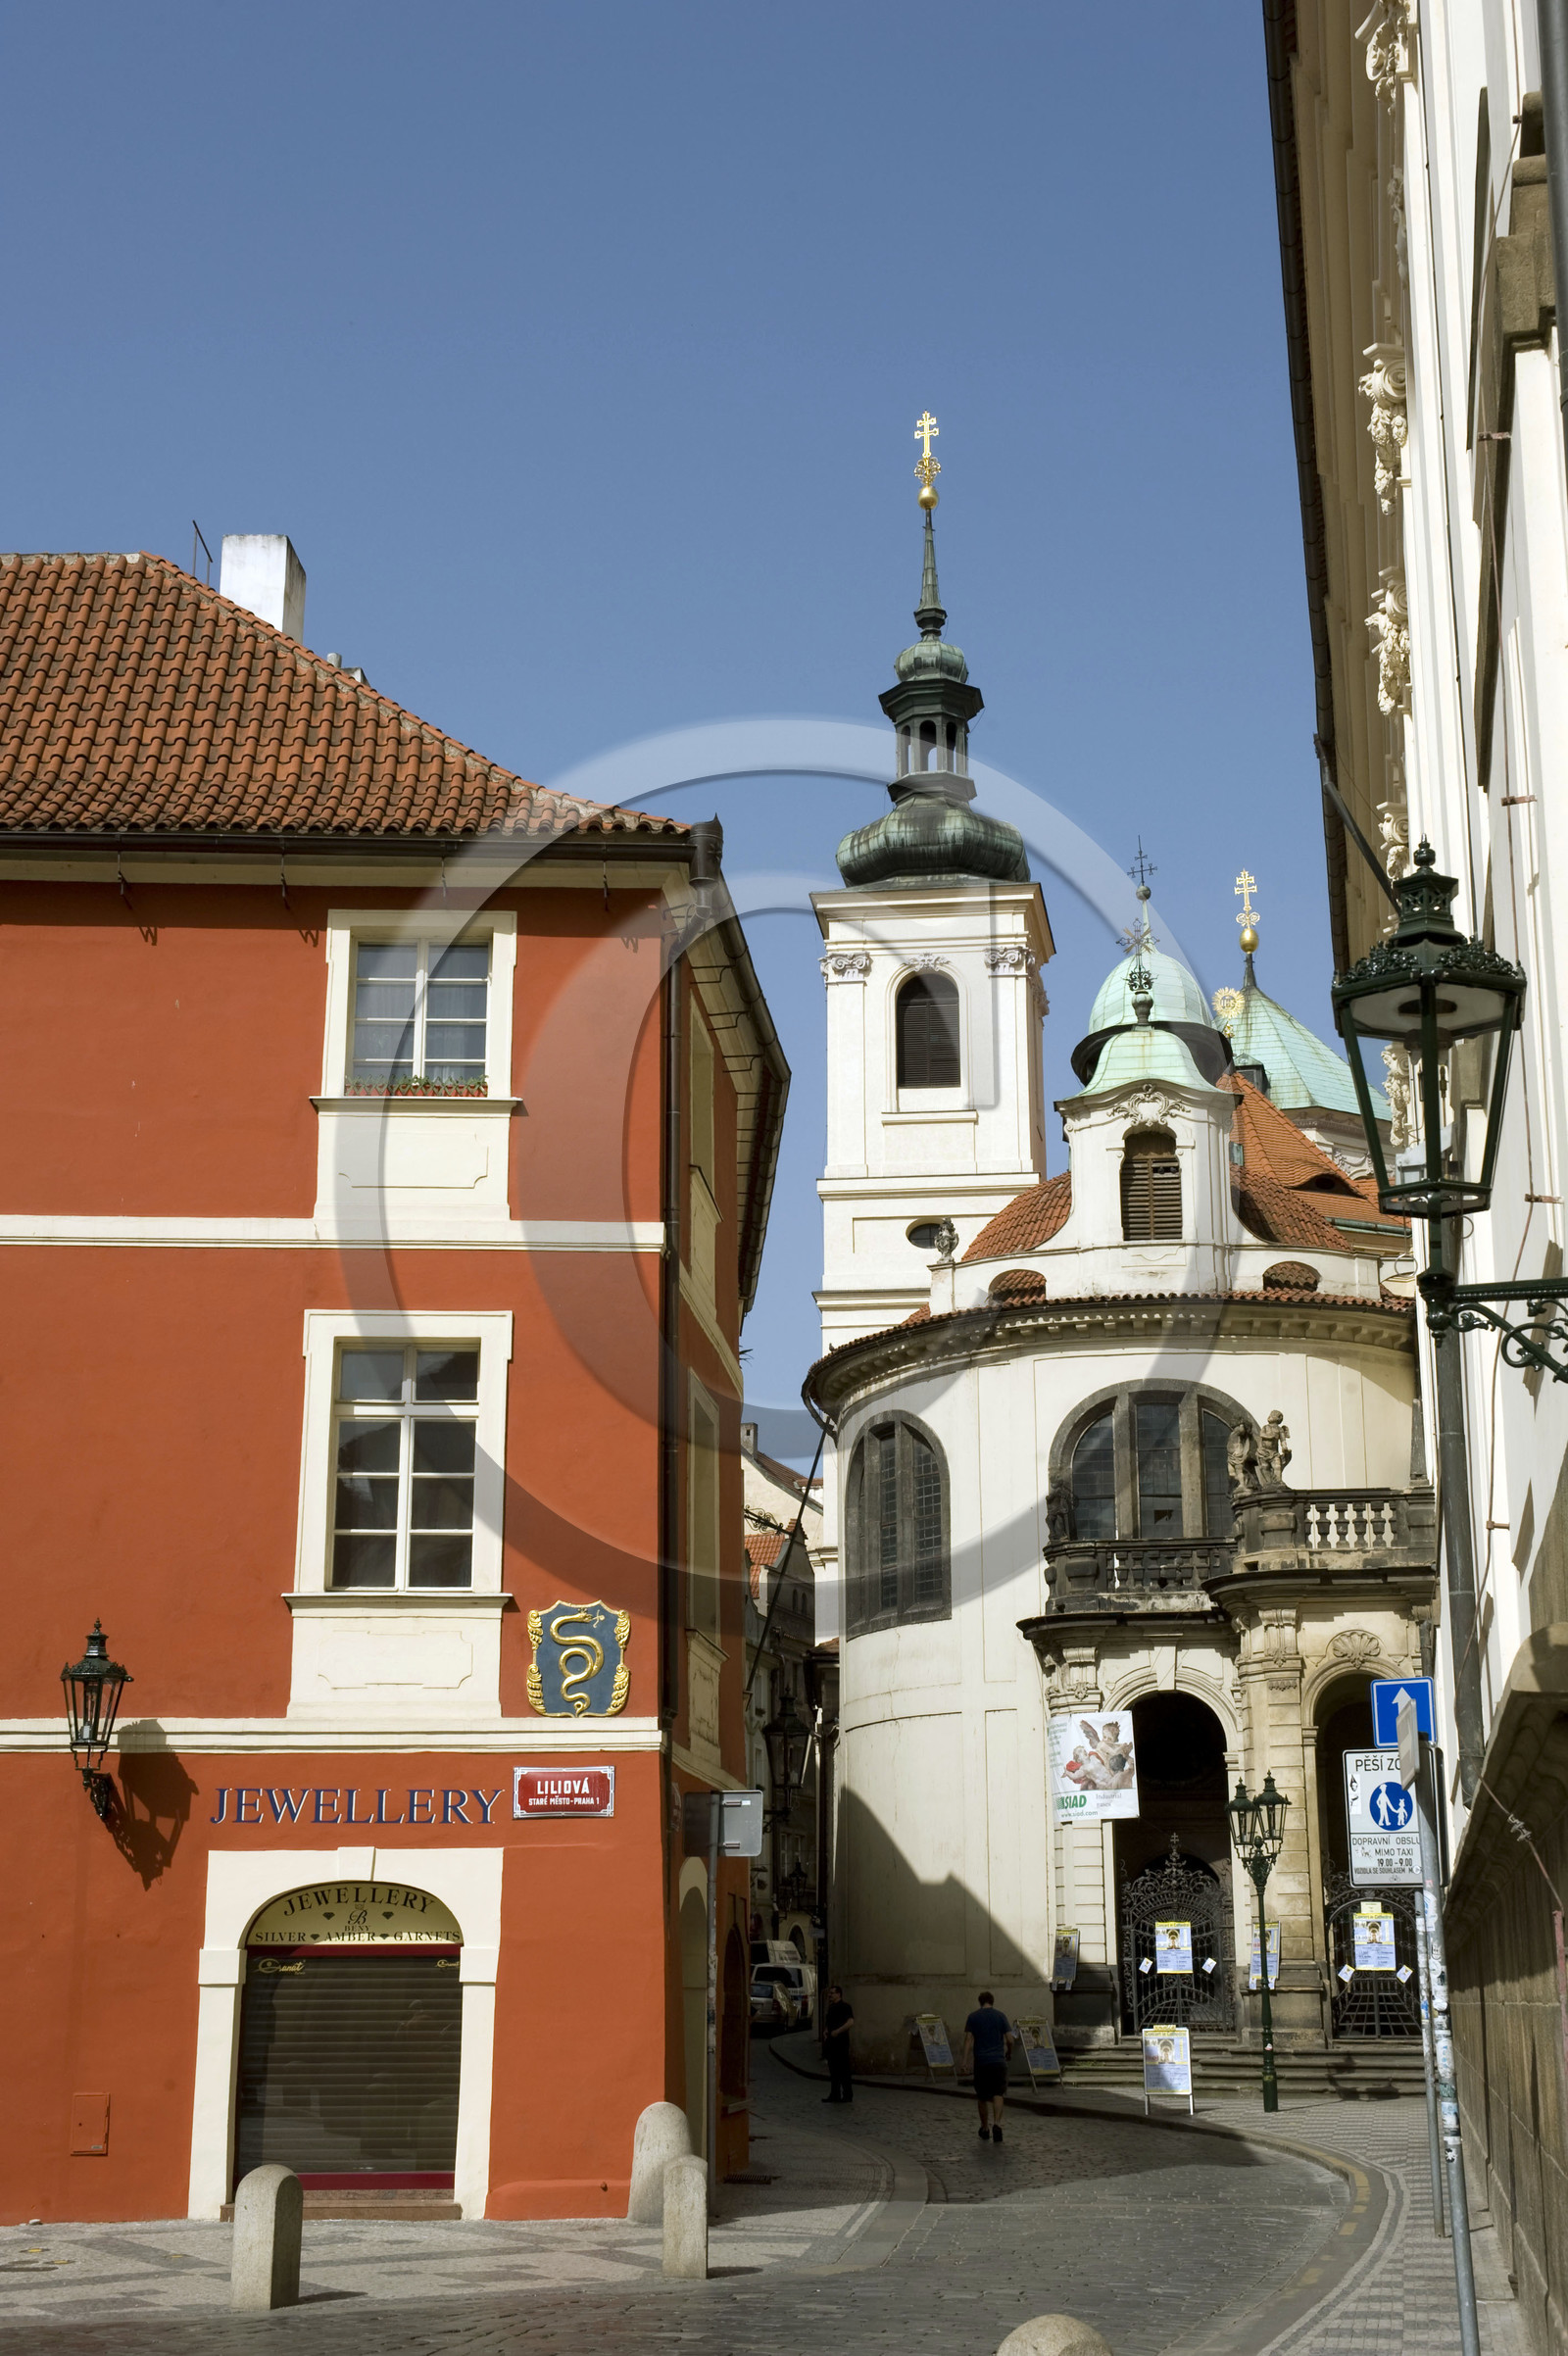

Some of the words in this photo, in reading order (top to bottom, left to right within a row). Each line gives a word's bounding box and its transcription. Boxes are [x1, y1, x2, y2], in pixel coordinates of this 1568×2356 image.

[1355, 1754, 1384, 1772] PĚŠÍ
[1387, 1754, 1401, 1771] ZÓ
[537, 1777, 590, 1794] LILIOVÁ
[210, 1788, 506, 1825] JEWELLERY
[529, 1795, 548, 1805] STARÉ
[1063, 1794, 1087, 1809] SIAD
[1351, 1835, 1391, 1845] DOPRAVNÍ
[1396, 1847, 1413, 1856] TAXI
[283, 1887, 435, 1917] JEWELLERY
[255, 1932, 307, 1942] SILVER
[324, 1932, 376, 1942] AMBER
[394, 1931, 461, 1941] GARNETS
